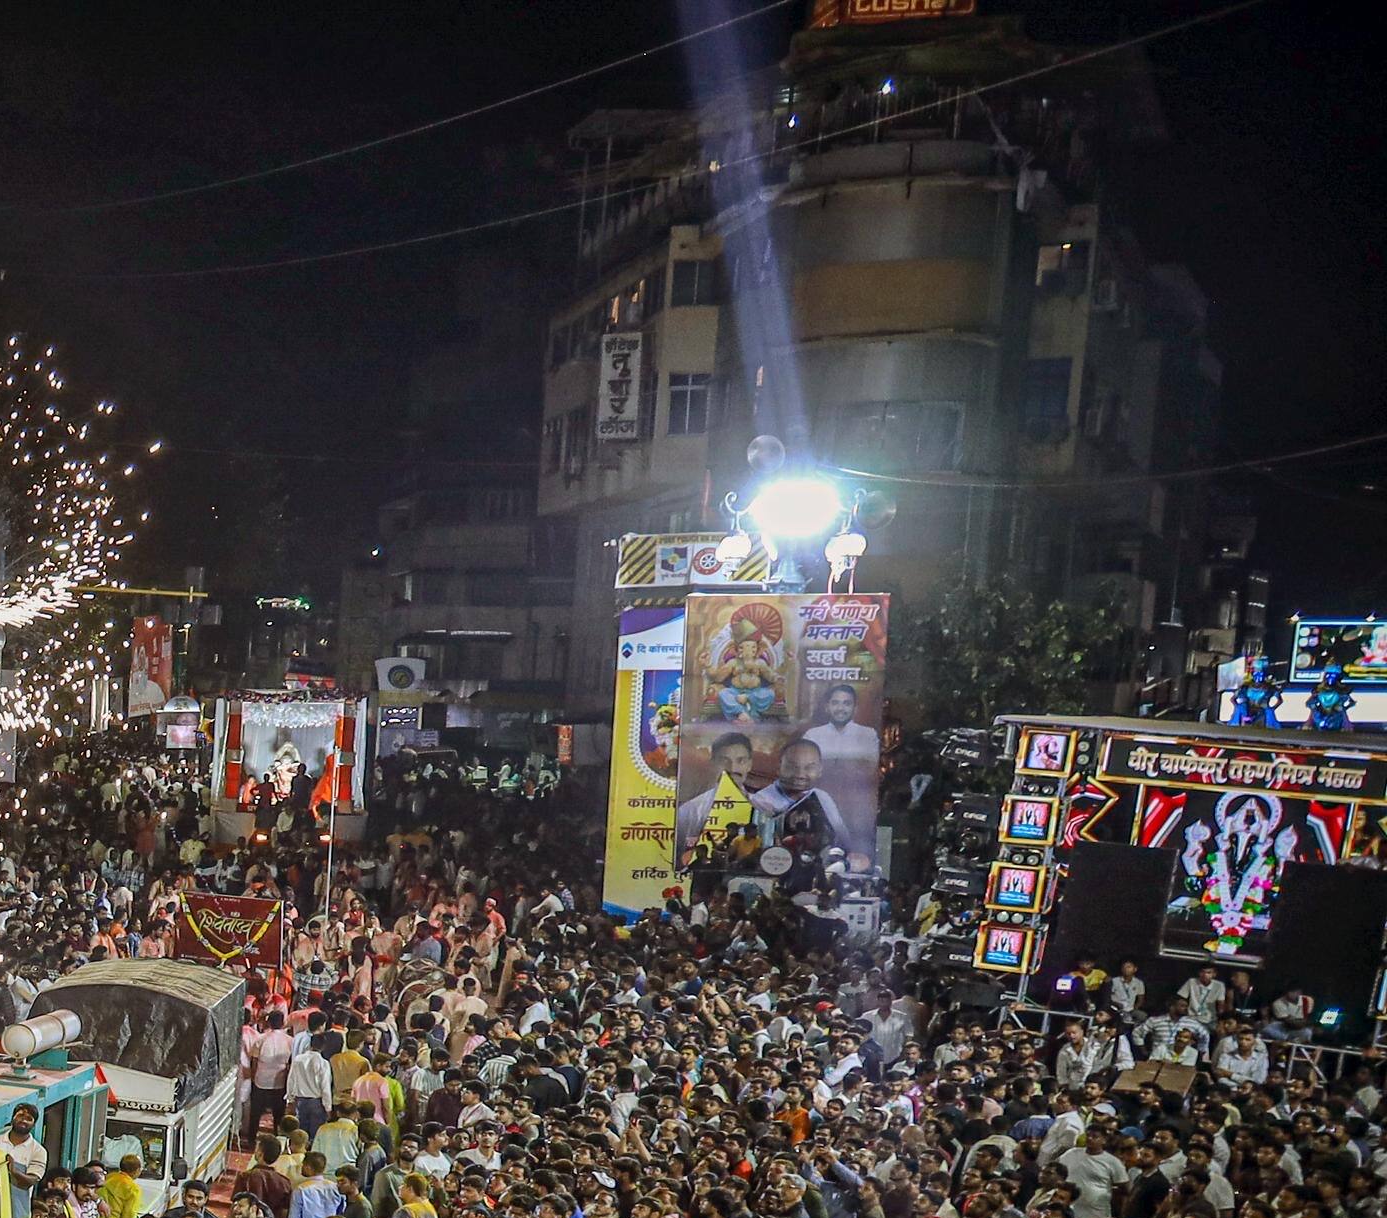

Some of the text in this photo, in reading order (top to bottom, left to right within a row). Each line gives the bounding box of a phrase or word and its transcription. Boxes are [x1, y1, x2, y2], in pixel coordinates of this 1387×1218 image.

[799, 600, 829, 621] सर्व
[807, 645, 847, 665] सहर्ष
[1274, 757, 1317, 785] मित्र
[1317, 761, 1367, 789] मंडळ
[631, 867, 669, 880] हार्दिक
